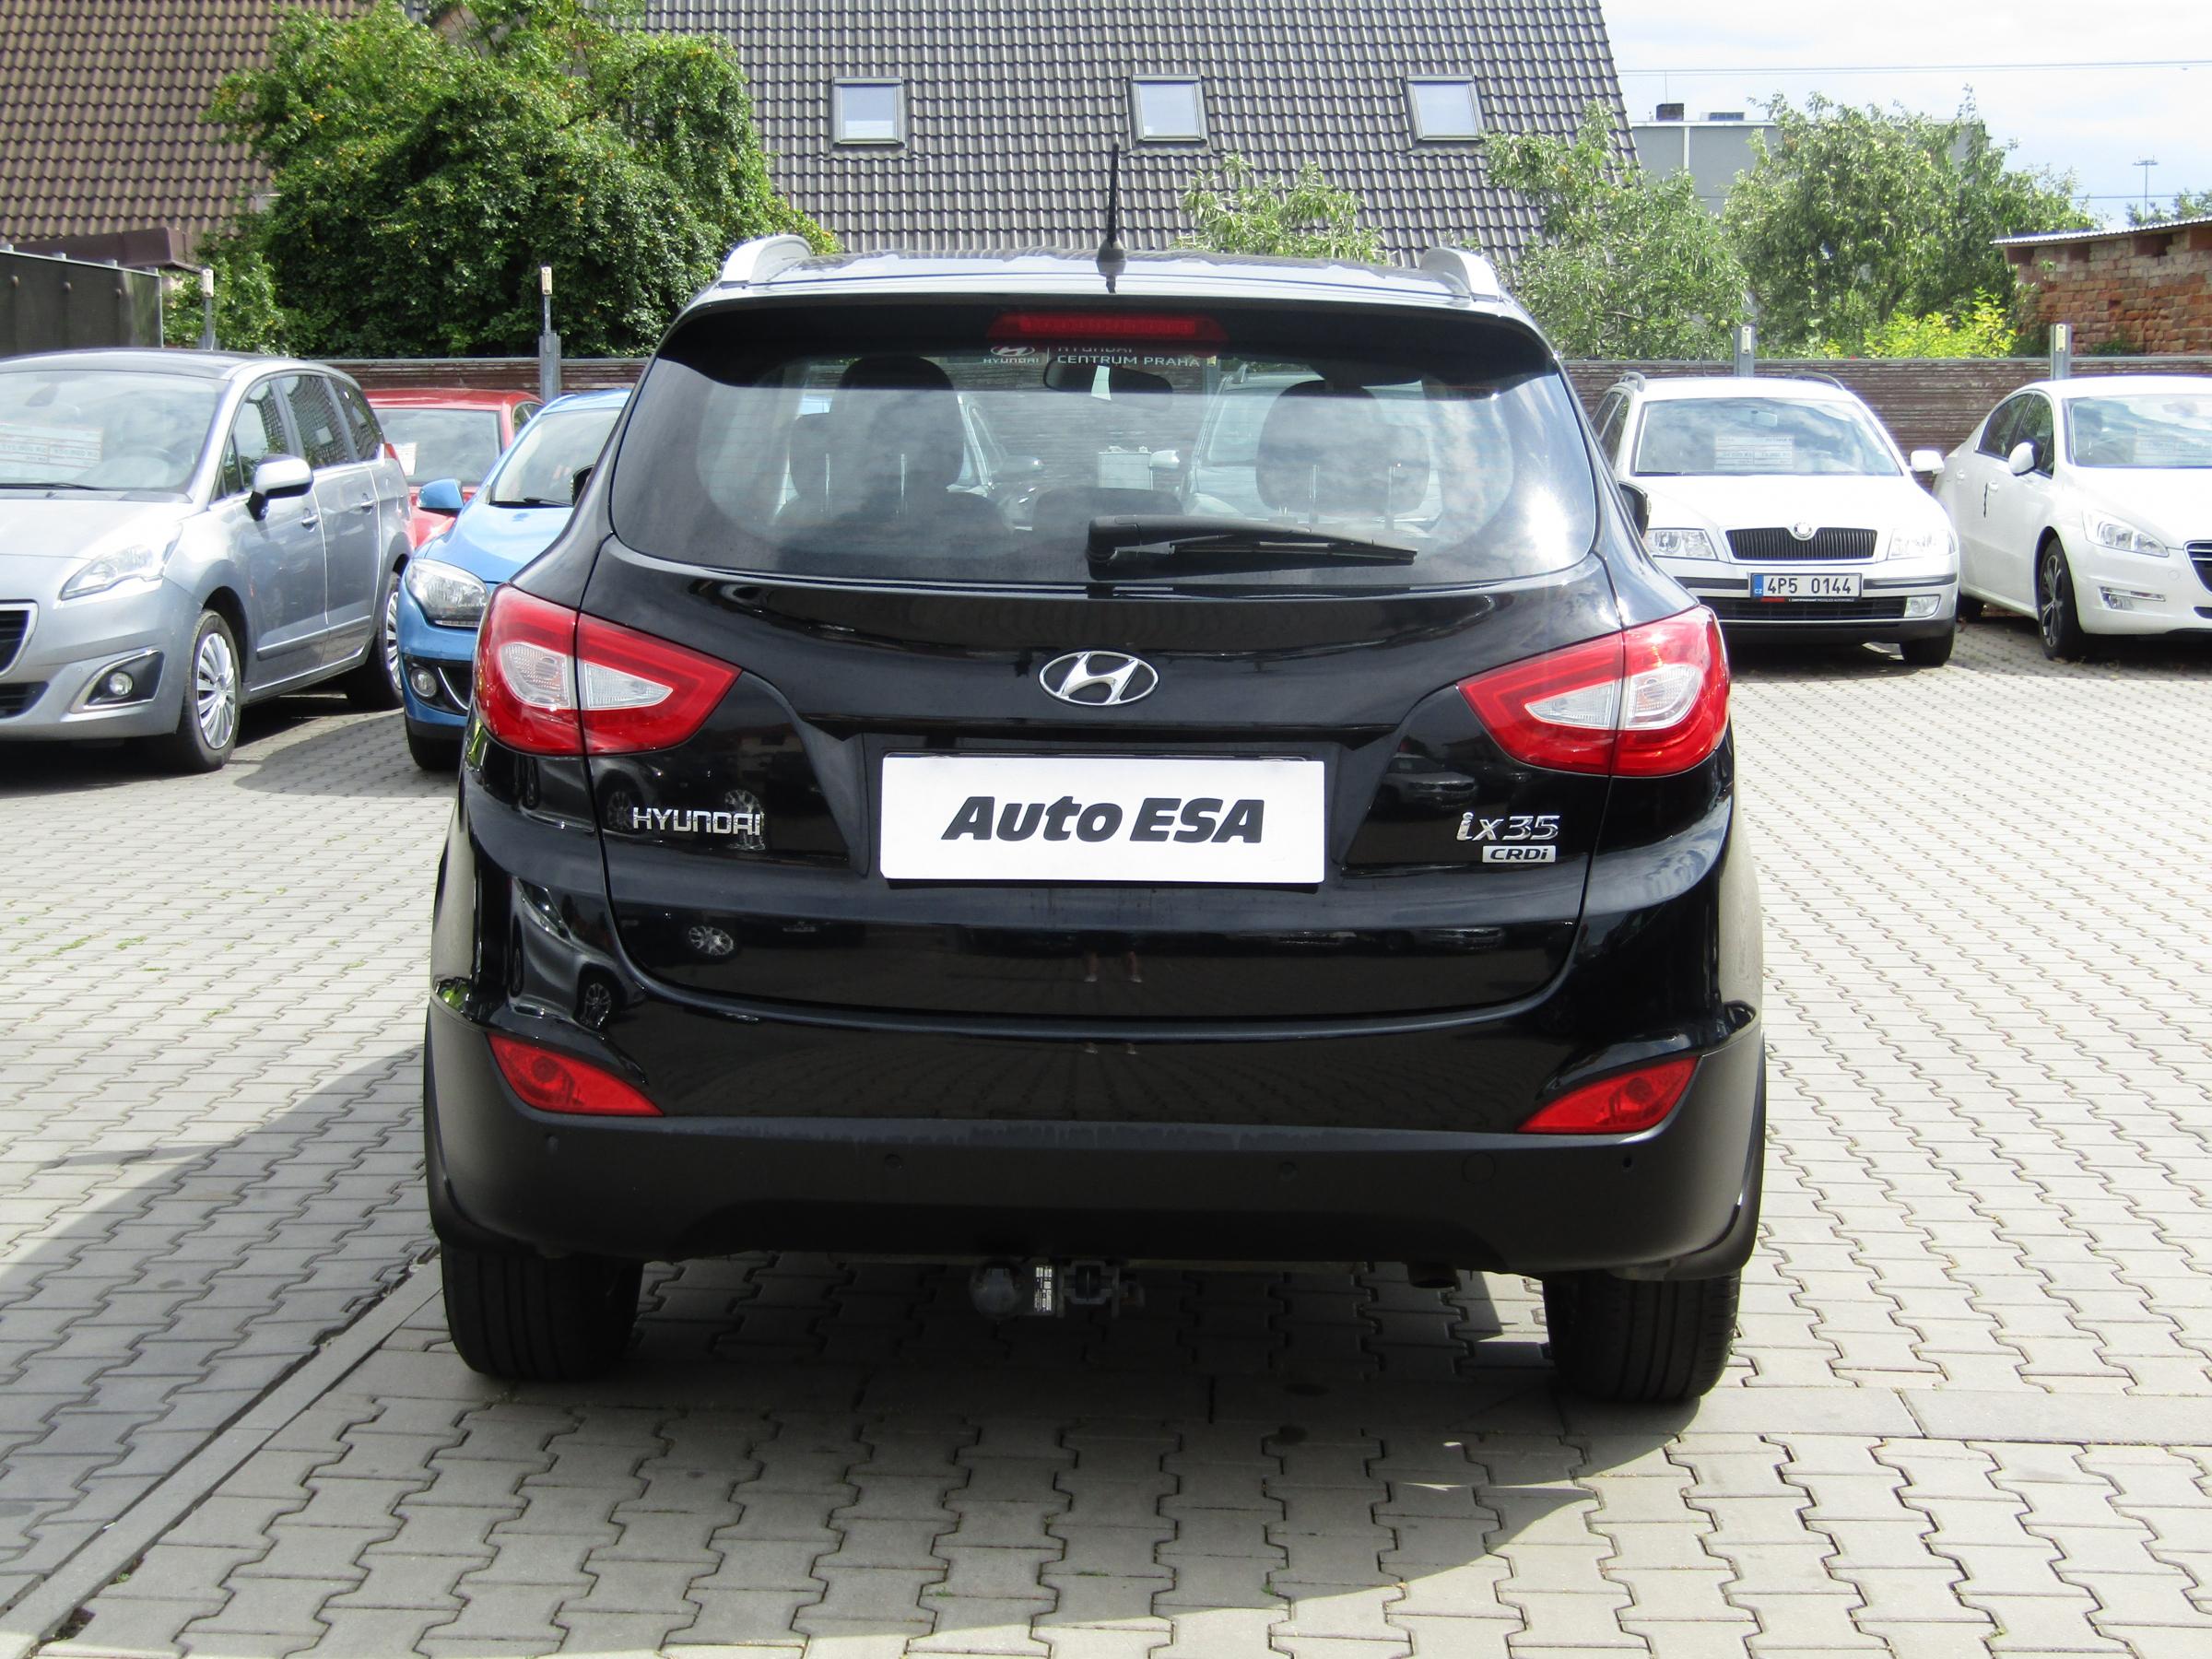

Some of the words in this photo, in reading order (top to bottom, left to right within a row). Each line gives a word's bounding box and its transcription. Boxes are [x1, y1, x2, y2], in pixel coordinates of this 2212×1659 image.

[1057, 355, 1137, 365] CENTRUM
[1144, 358, 1200, 368] PRAHA
[1767, 577, 1798, 594] 4P5
[1811, 577, 1852, 594] 0144
[632, 806, 760, 836] HYUNDAI
[940, 795, 1123, 842] Auto
[1129, 797, 1265, 843] ESA
[1456, 812, 1560, 841] ix35
[1489, 848, 1548, 860] CRDi
